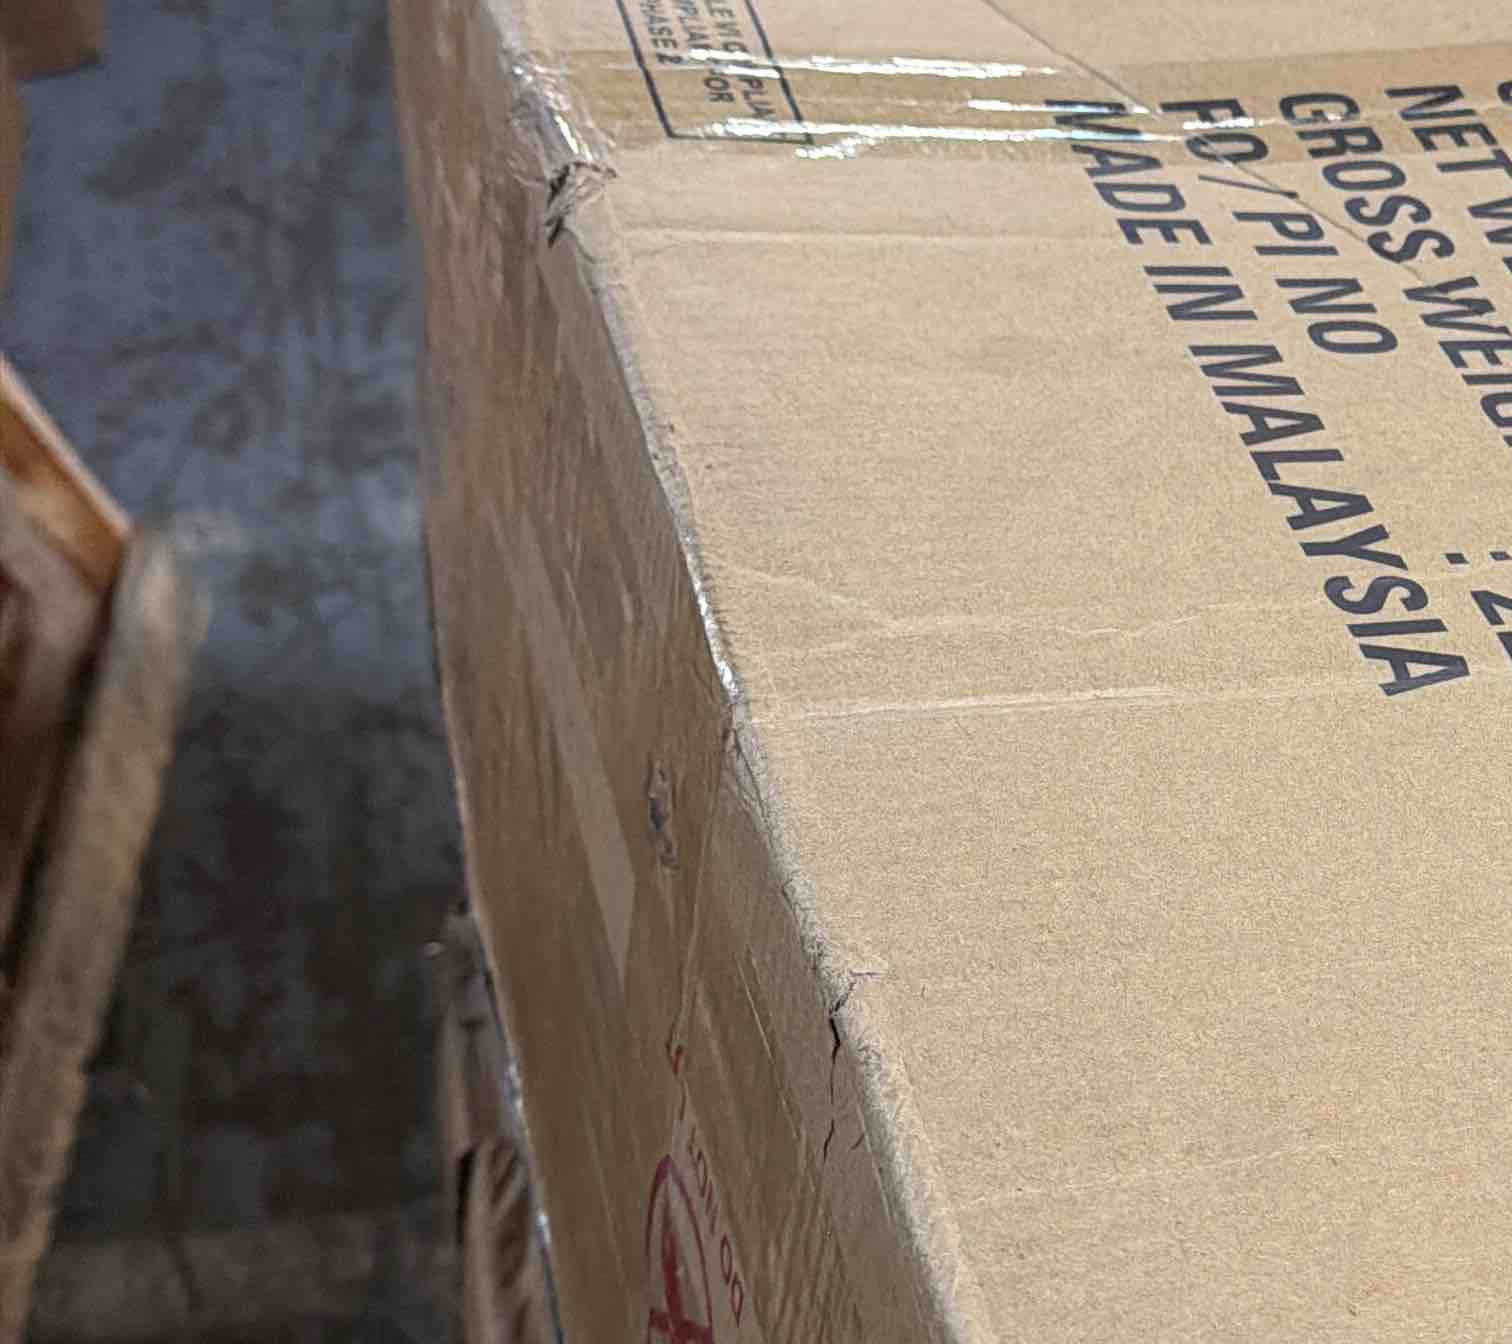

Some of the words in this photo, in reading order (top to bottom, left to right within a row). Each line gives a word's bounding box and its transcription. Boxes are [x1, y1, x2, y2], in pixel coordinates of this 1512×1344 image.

[1045, 99, 1210, 244] MADE
[1279, 93, 1454, 263] GROSS
[1234, 212, 1337, 255] PI
[1144, 267, 1257, 320] IN
[1276, 279, 1397, 353] NO
[1190, 346, 1469, 696] MALAYSIA
